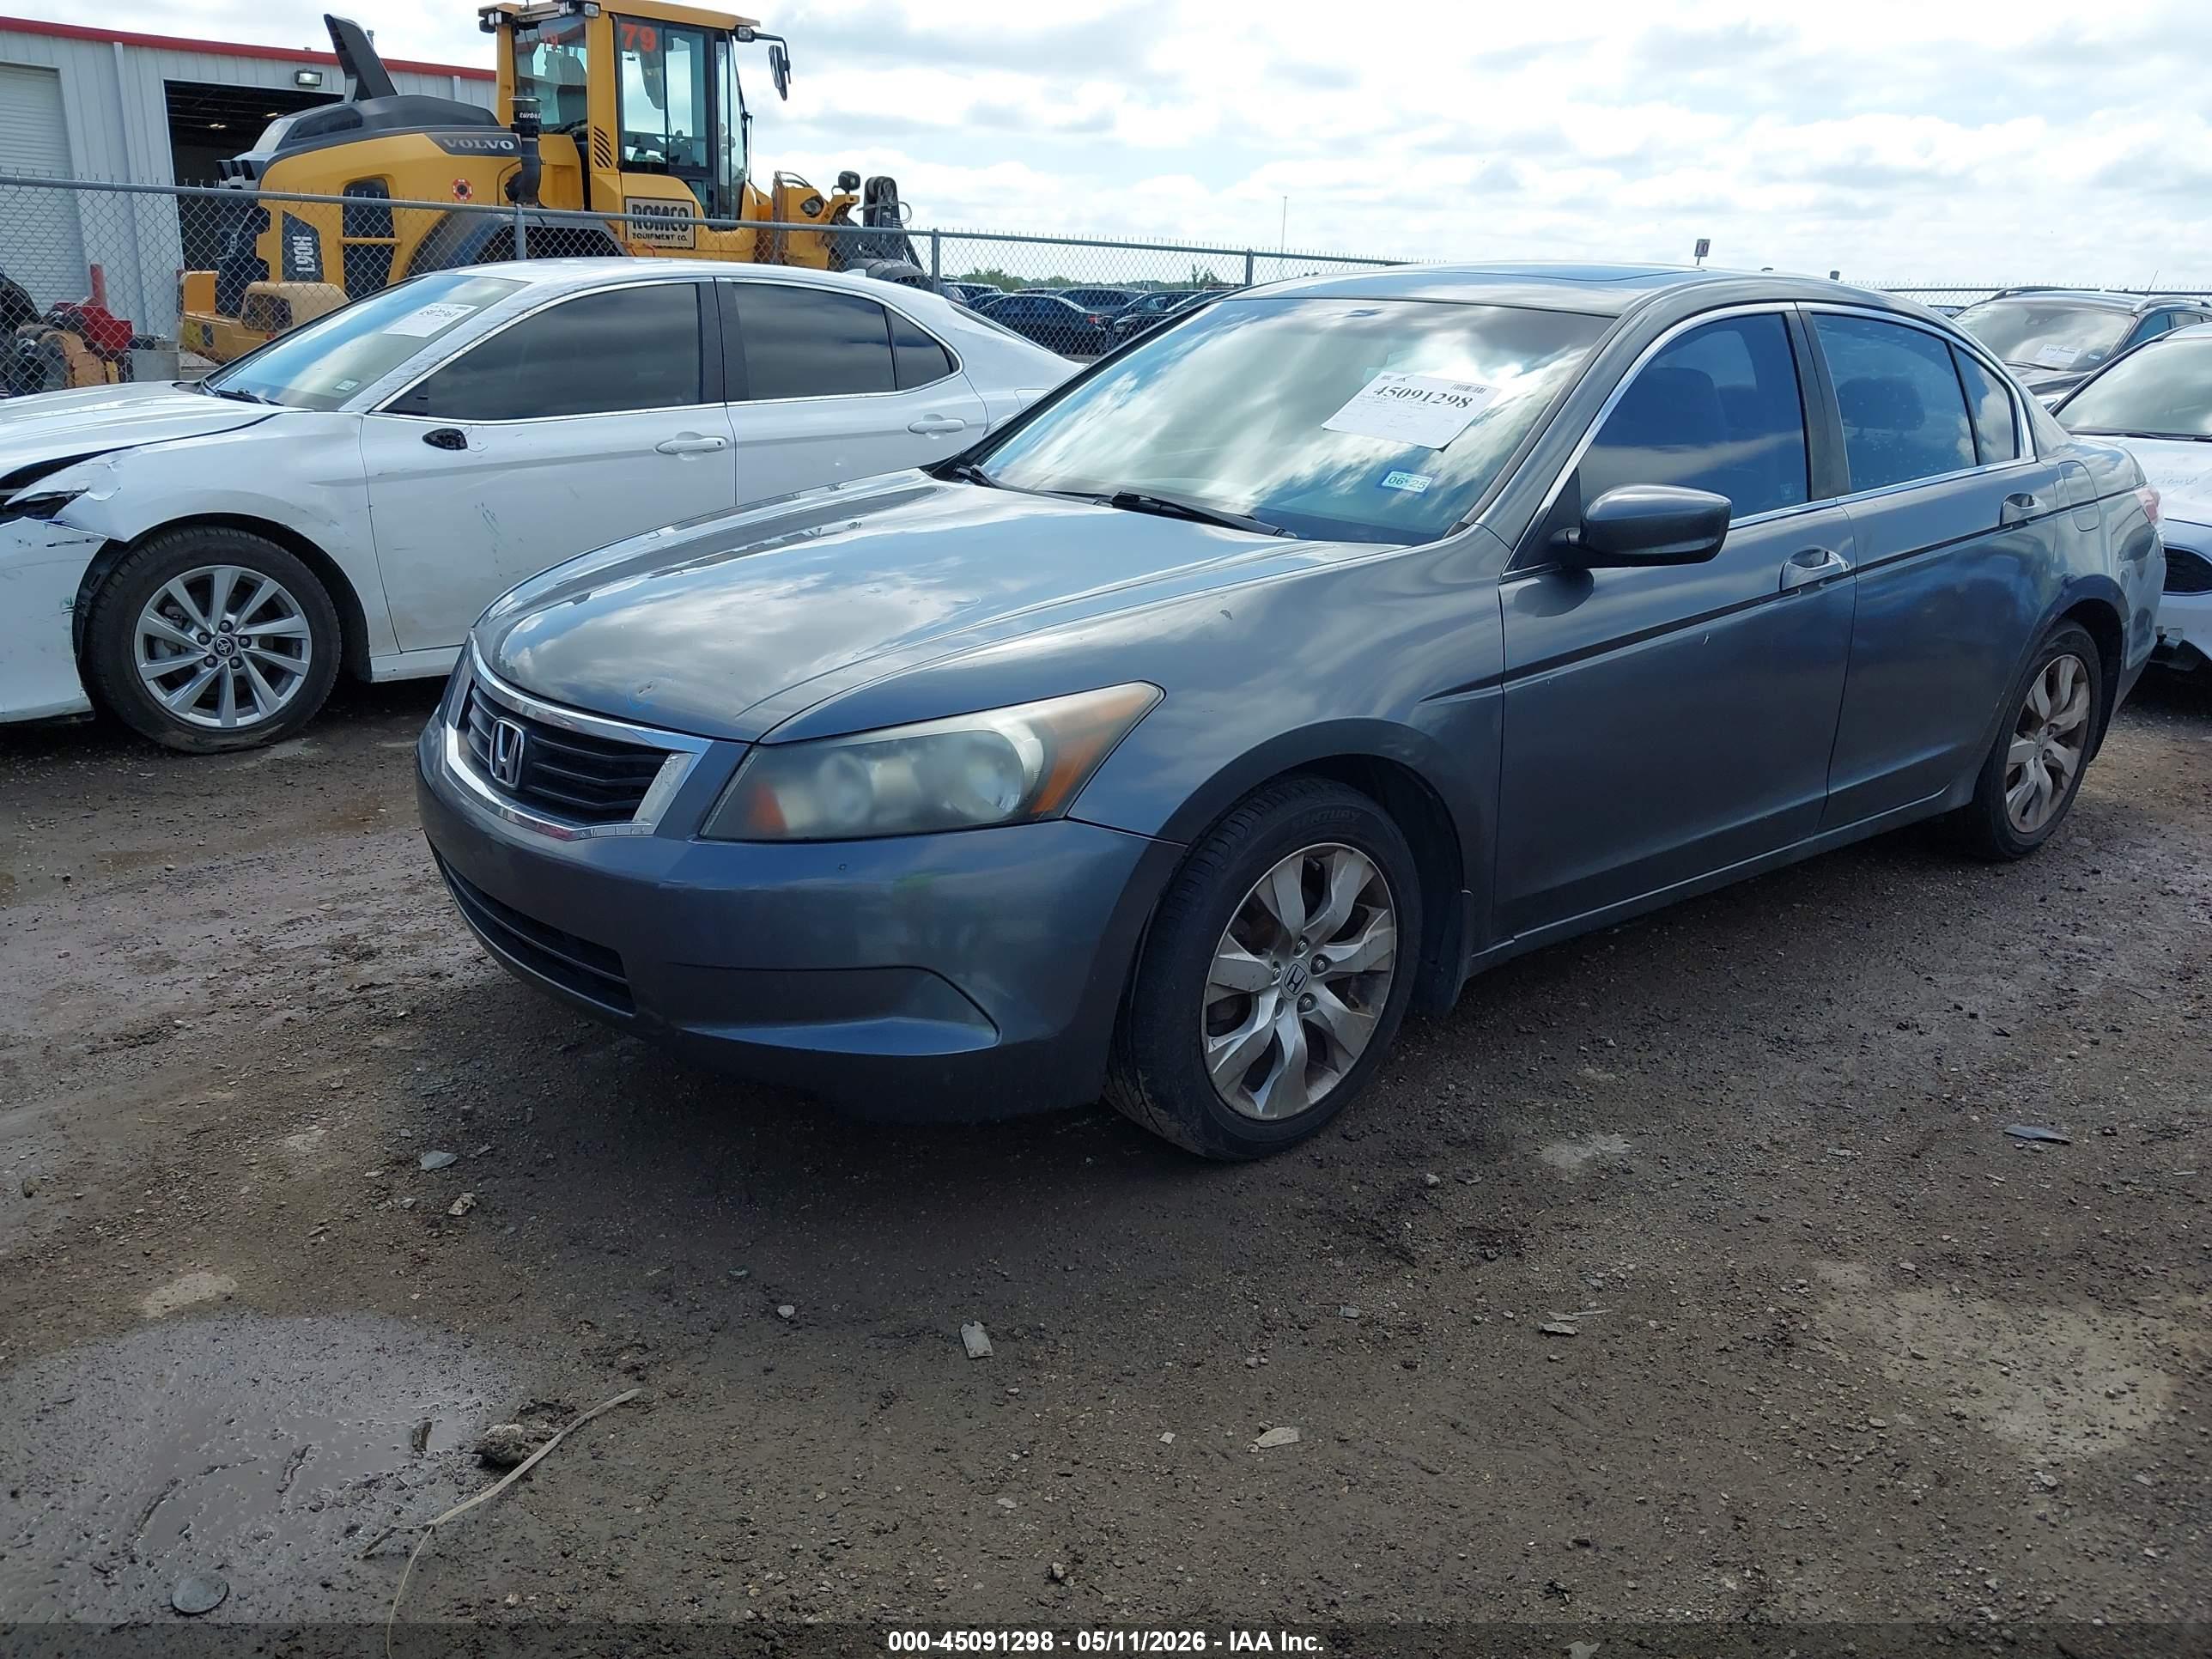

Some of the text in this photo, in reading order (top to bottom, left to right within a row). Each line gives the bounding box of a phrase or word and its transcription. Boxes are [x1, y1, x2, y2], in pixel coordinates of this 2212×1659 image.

[619, 22, 657, 52] 79
[442, 138, 514, 150] VOLVO
[632, 204, 689, 232] ROMCO
[632, 232, 675, 240] EQUIPMENT
[292, 235, 316, 272] L90H
[1373, 385, 1474, 409] 45091298
[1389, 476, 1427, 489] 06 25
